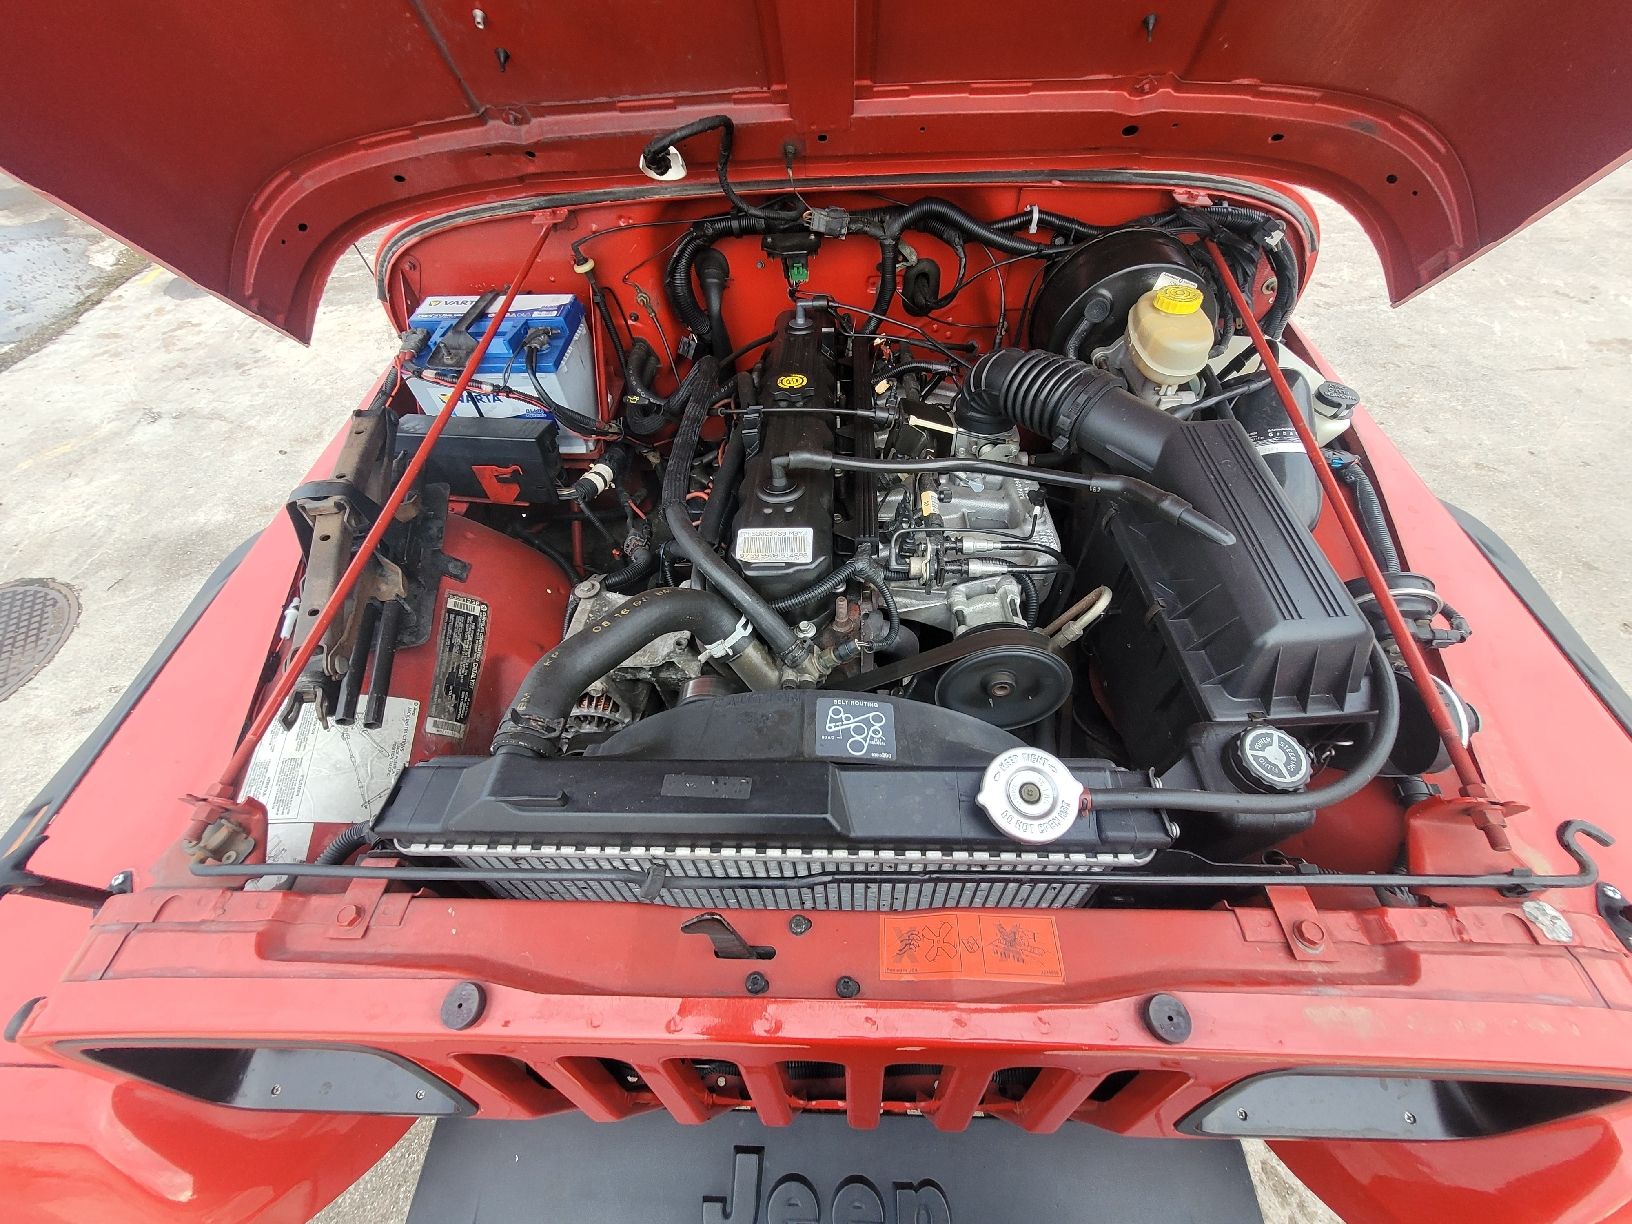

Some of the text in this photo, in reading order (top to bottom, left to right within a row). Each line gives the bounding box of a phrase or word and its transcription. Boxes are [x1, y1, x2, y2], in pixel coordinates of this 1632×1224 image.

[850, 700, 879, 708] ROUTING
[1021, 753, 1049, 766] TIGHT
[1254, 736, 1297, 773] POWER STEERING FLUID
[1001, 809, 1014, 824] DO
[1015, 819, 1035, 833] NOT
